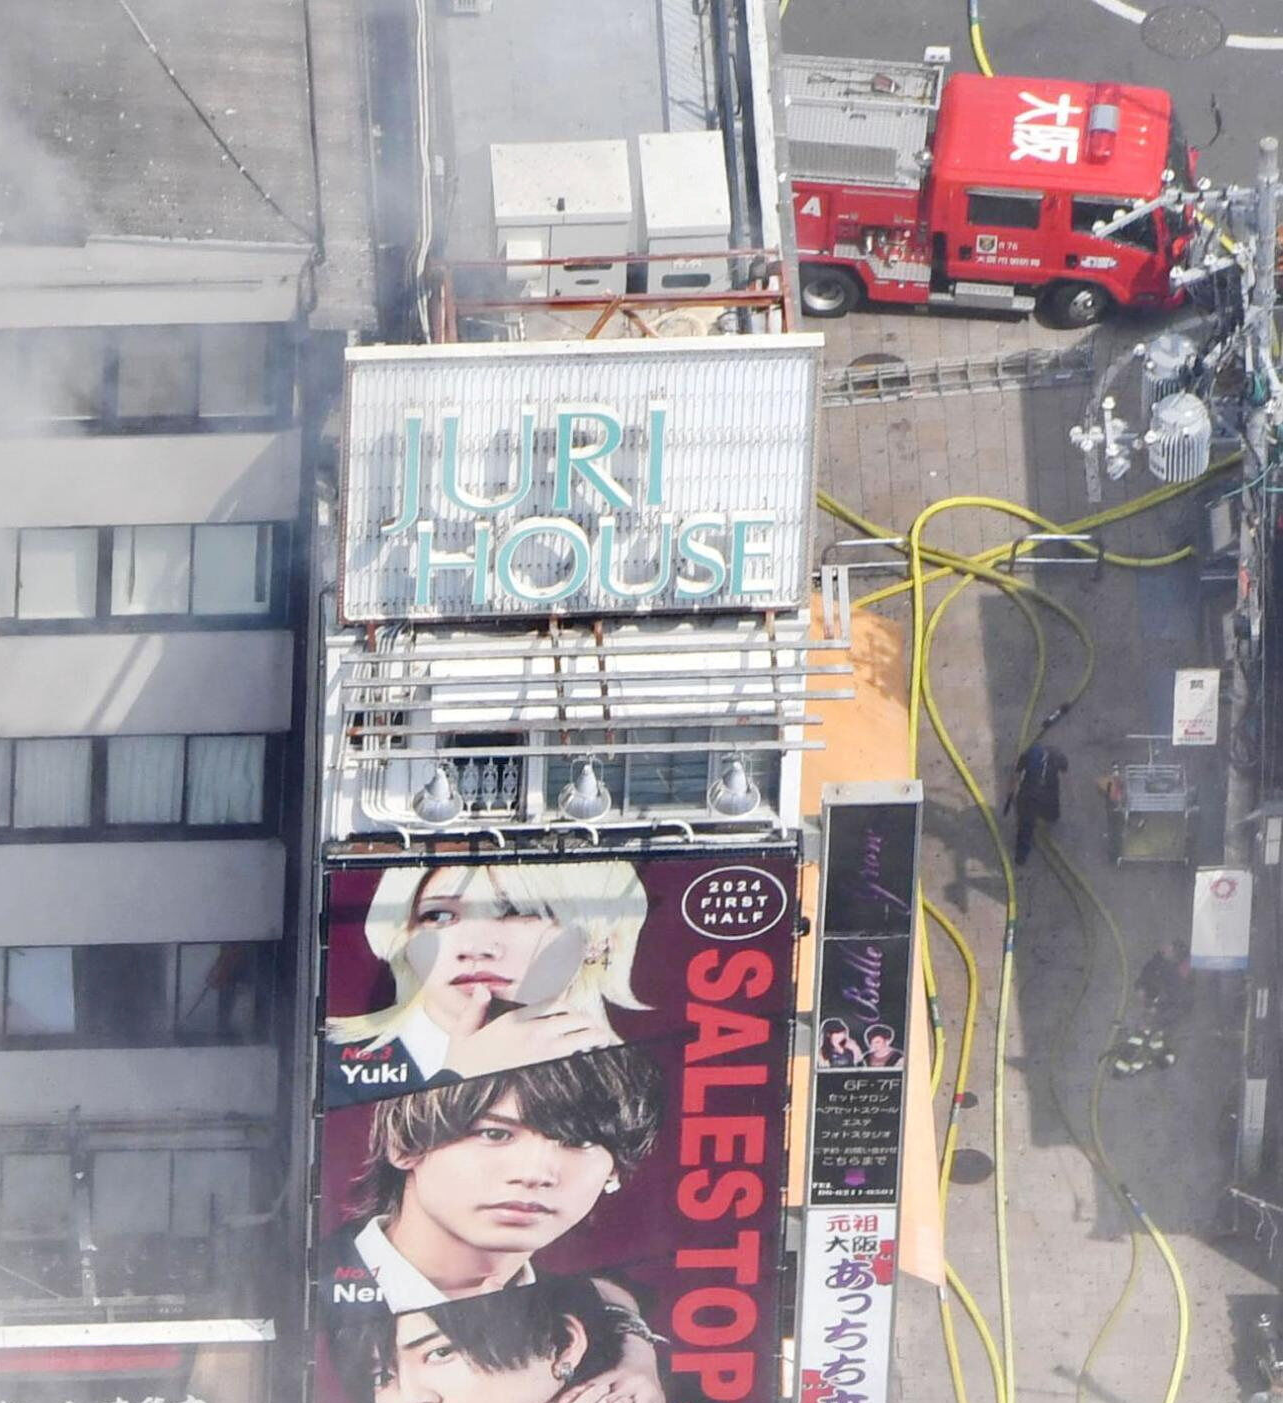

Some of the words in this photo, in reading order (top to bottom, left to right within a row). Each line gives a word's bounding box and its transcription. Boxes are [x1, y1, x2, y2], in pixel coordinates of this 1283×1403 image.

[1011, 91, 1083, 163] 大阪
[382, 398, 670, 534] JURI
[415, 511, 776, 605] HOUSE
[709, 880, 762, 893] 2024
[701, 895, 768, 909] FIRST
[704, 911, 764, 925] HALF
[340, 1063, 408, 1084] Yuki
[677, 948, 774, 1221] SALES
[825, 1214, 879, 1232] 元祖
[825, 1236, 878, 1253] 大阪
